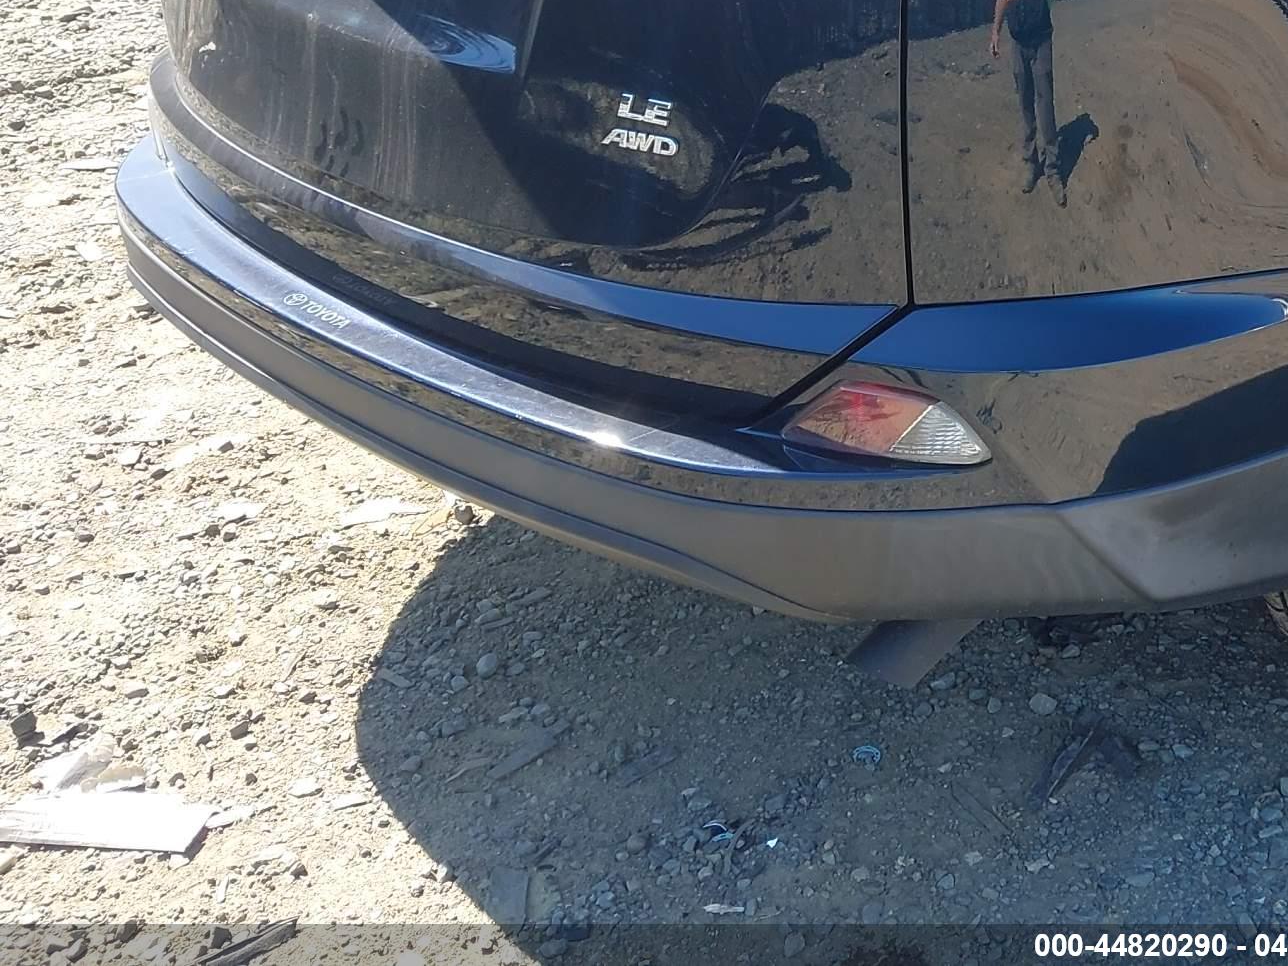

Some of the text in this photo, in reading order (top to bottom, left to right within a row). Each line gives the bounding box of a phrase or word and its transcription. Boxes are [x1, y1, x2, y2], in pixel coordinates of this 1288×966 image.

[617, 93, 672, 126] LE
[600, 128, 679, 156] AWD
[301, 299, 350, 330] TOYOTA
